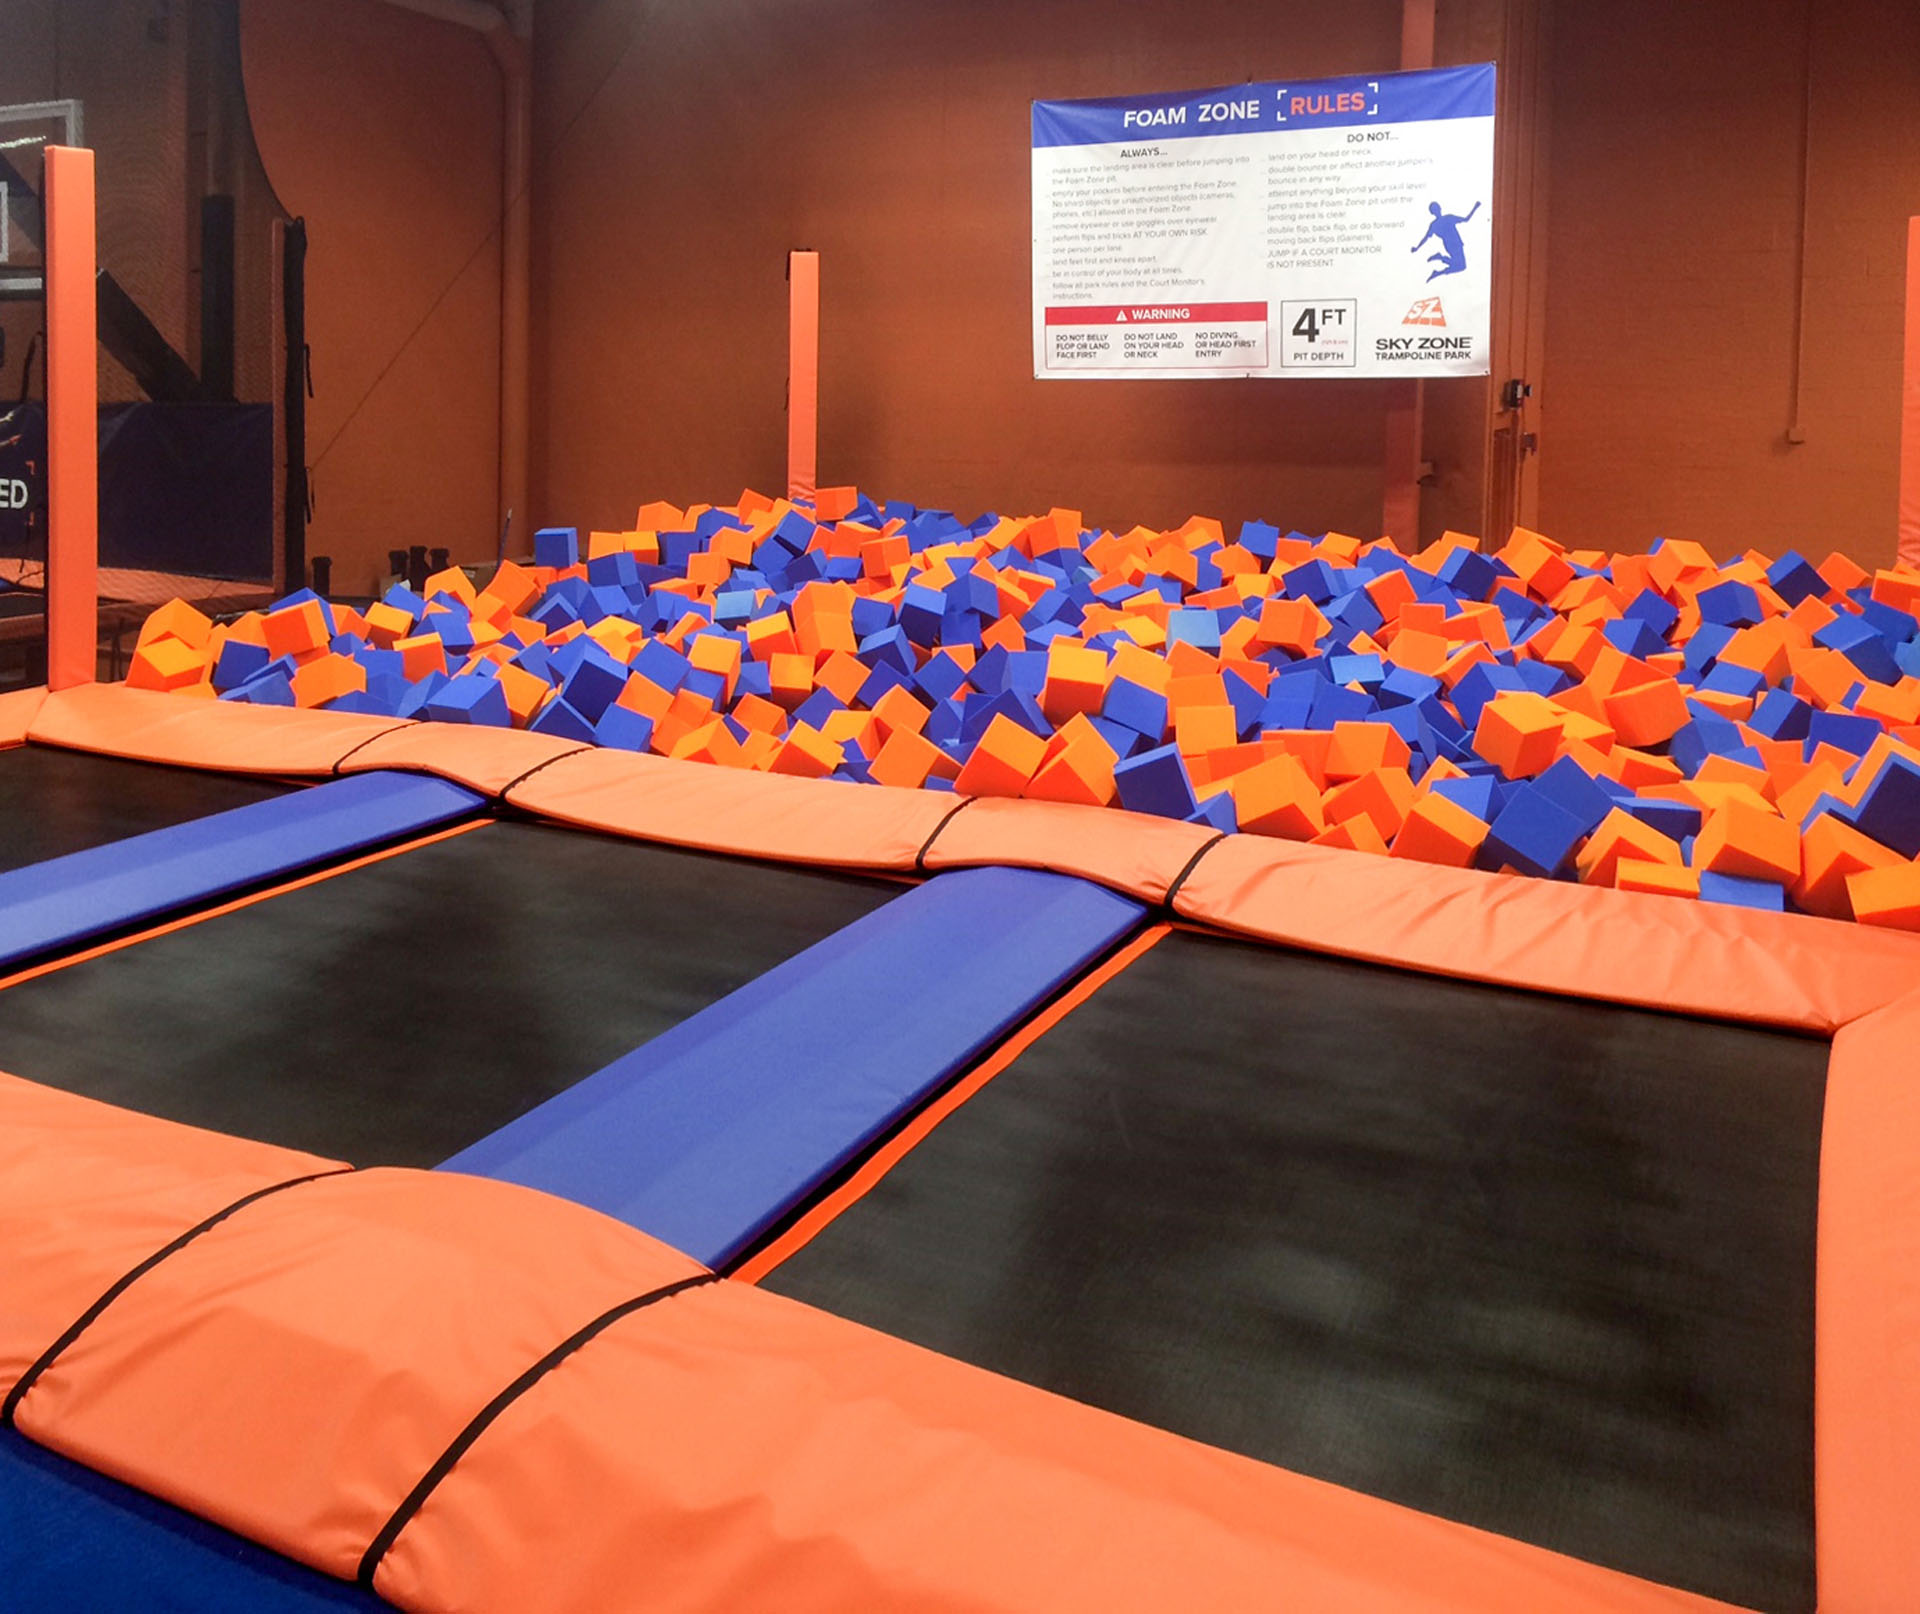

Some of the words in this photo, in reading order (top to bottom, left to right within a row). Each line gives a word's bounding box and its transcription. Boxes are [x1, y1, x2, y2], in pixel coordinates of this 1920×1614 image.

[1123, 106, 1186, 128] FOAM
[1198, 100, 1260, 122] ZONE
[1290, 92, 1366, 115] RULES
[1347, 133, 1364, 143] DO
[1120, 147, 1168, 158] ALWAYS...
[1132, 308, 1190, 320] WARNING
[1292, 308, 1319, 342] 4
[1322, 309, 1346, 325] FT
[1156, 332, 1177, 340] LAND
[1089, 342, 1110, 350] LAND
[1376, 338, 1413, 350] SKY
[1418, 337, 1472, 349] ZONE
[1294, 352, 1308, 360] PIT
[1311, 352, 1344, 360] DEPTH
[1376, 351, 1442, 360] TRAMPOLINE
[1444, 351, 1471, 359] PARK
